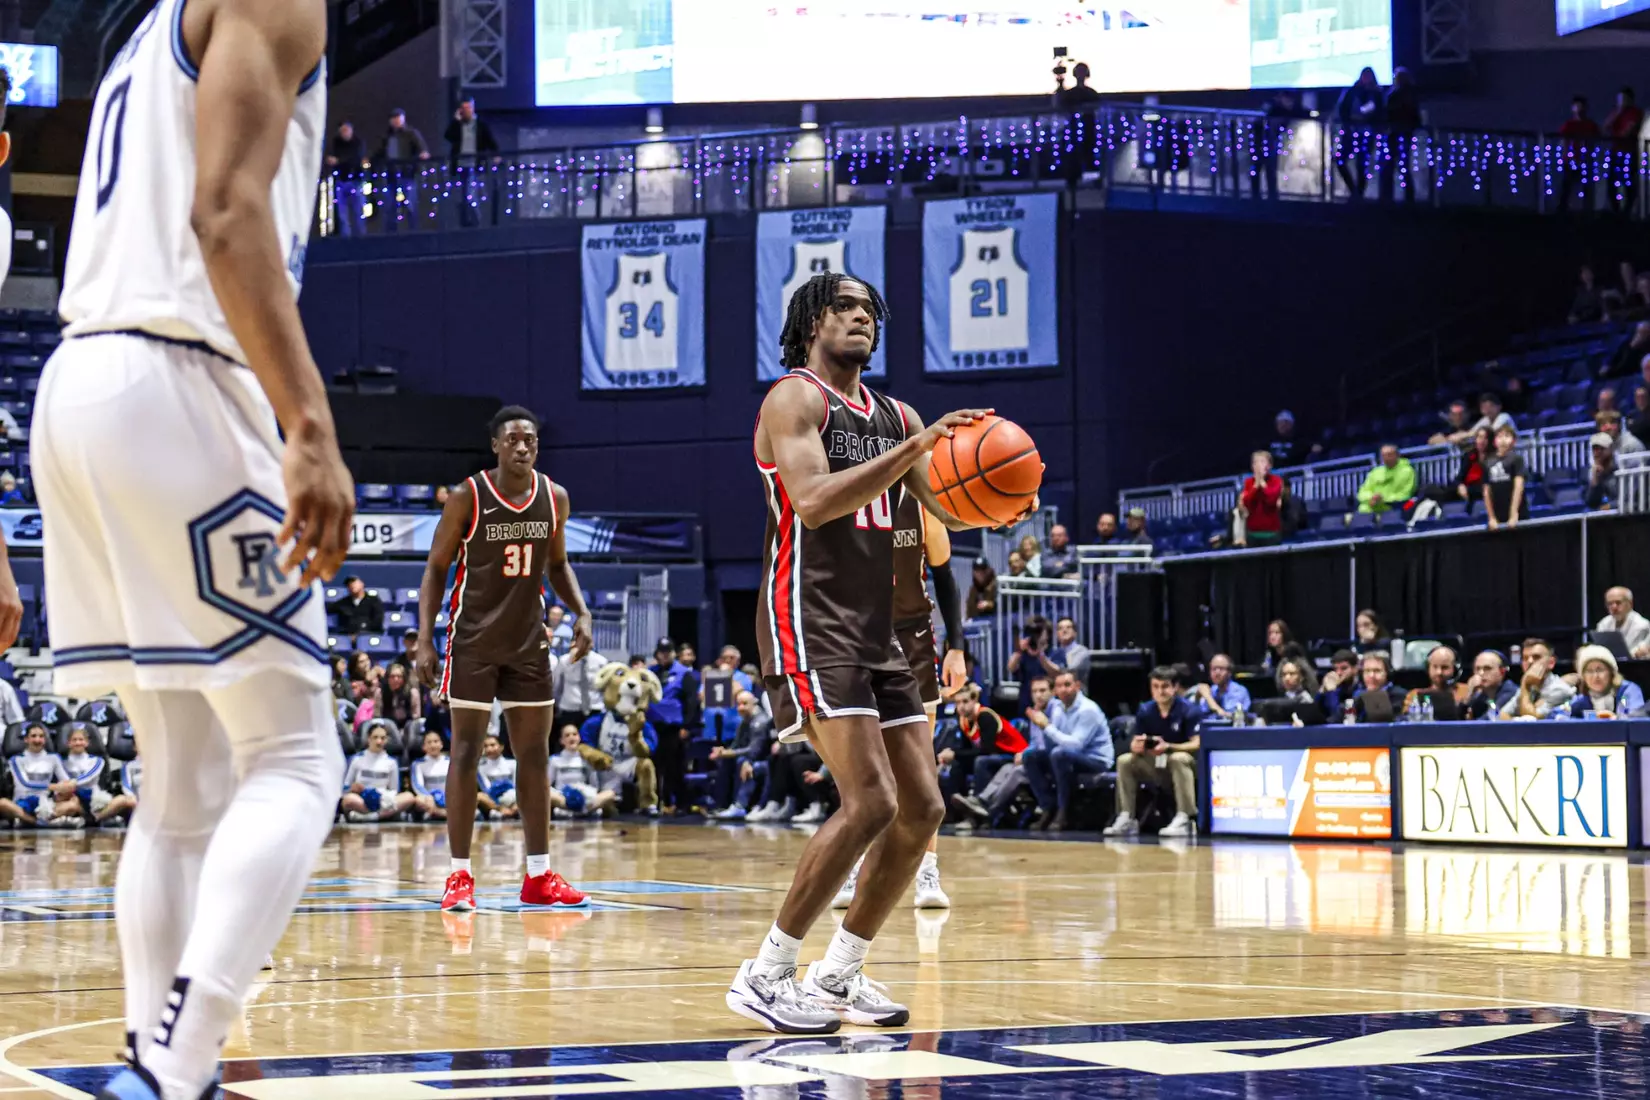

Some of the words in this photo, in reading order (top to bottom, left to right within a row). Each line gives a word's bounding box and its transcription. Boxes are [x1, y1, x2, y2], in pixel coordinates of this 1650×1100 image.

[96, 74, 132, 214] 0
[791, 208, 852, 223] CUTTINO
[954, 208, 1025, 225] WHEELER
[614, 223, 676, 236] ANTONIO
[791, 222, 850, 235] MOBLEY
[586, 234, 659, 250] REYNOLDS
[662, 232, 701, 246] DEAN
[970, 277, 1008, 318] 21
[618, 301, 665, 339] 34
[351, 523, 393, 545] 109
[486, 521, 549, 541] BROWN
[502, 542, 534, 578] 31
